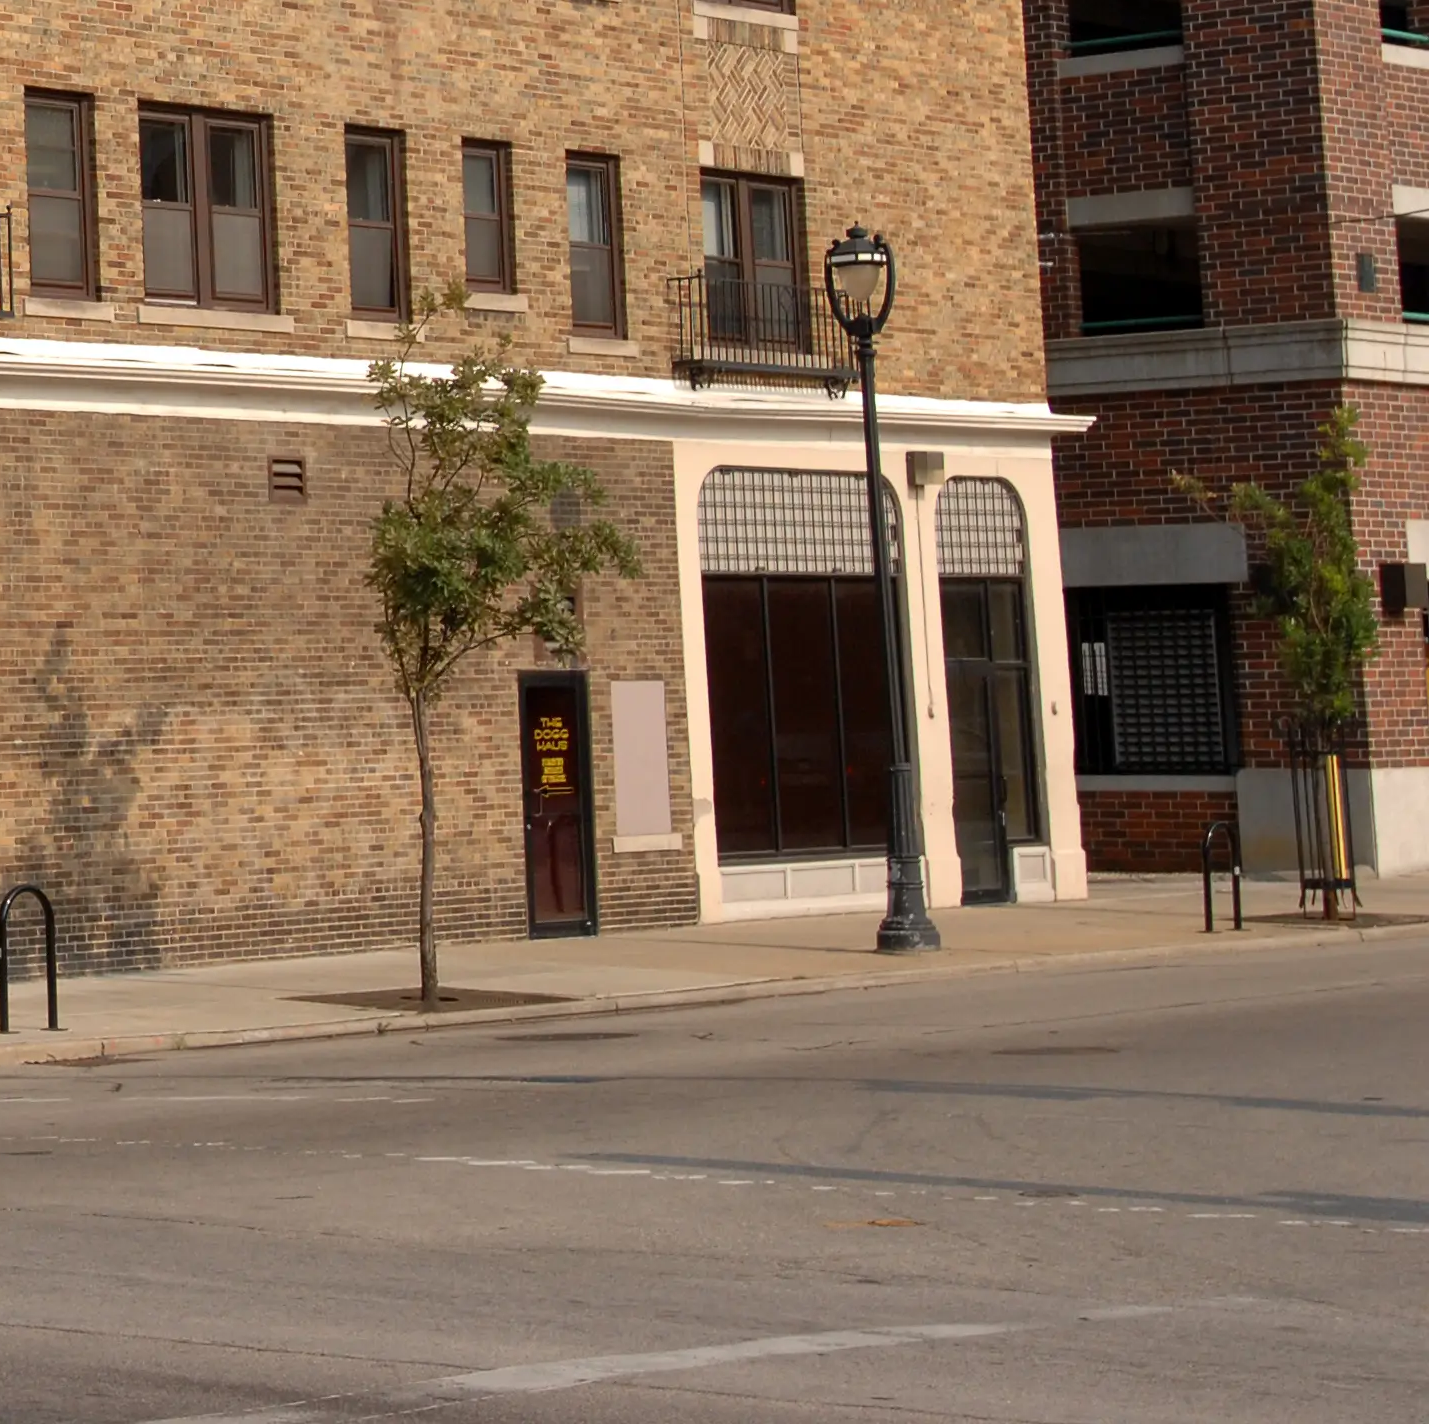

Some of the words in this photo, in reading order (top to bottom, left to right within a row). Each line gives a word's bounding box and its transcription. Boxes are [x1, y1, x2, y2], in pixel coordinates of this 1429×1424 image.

[541, 717, 563, 728] THE
[534, 729, 569, 740] DOGG
[537, 740, 568, 751] HAUS
